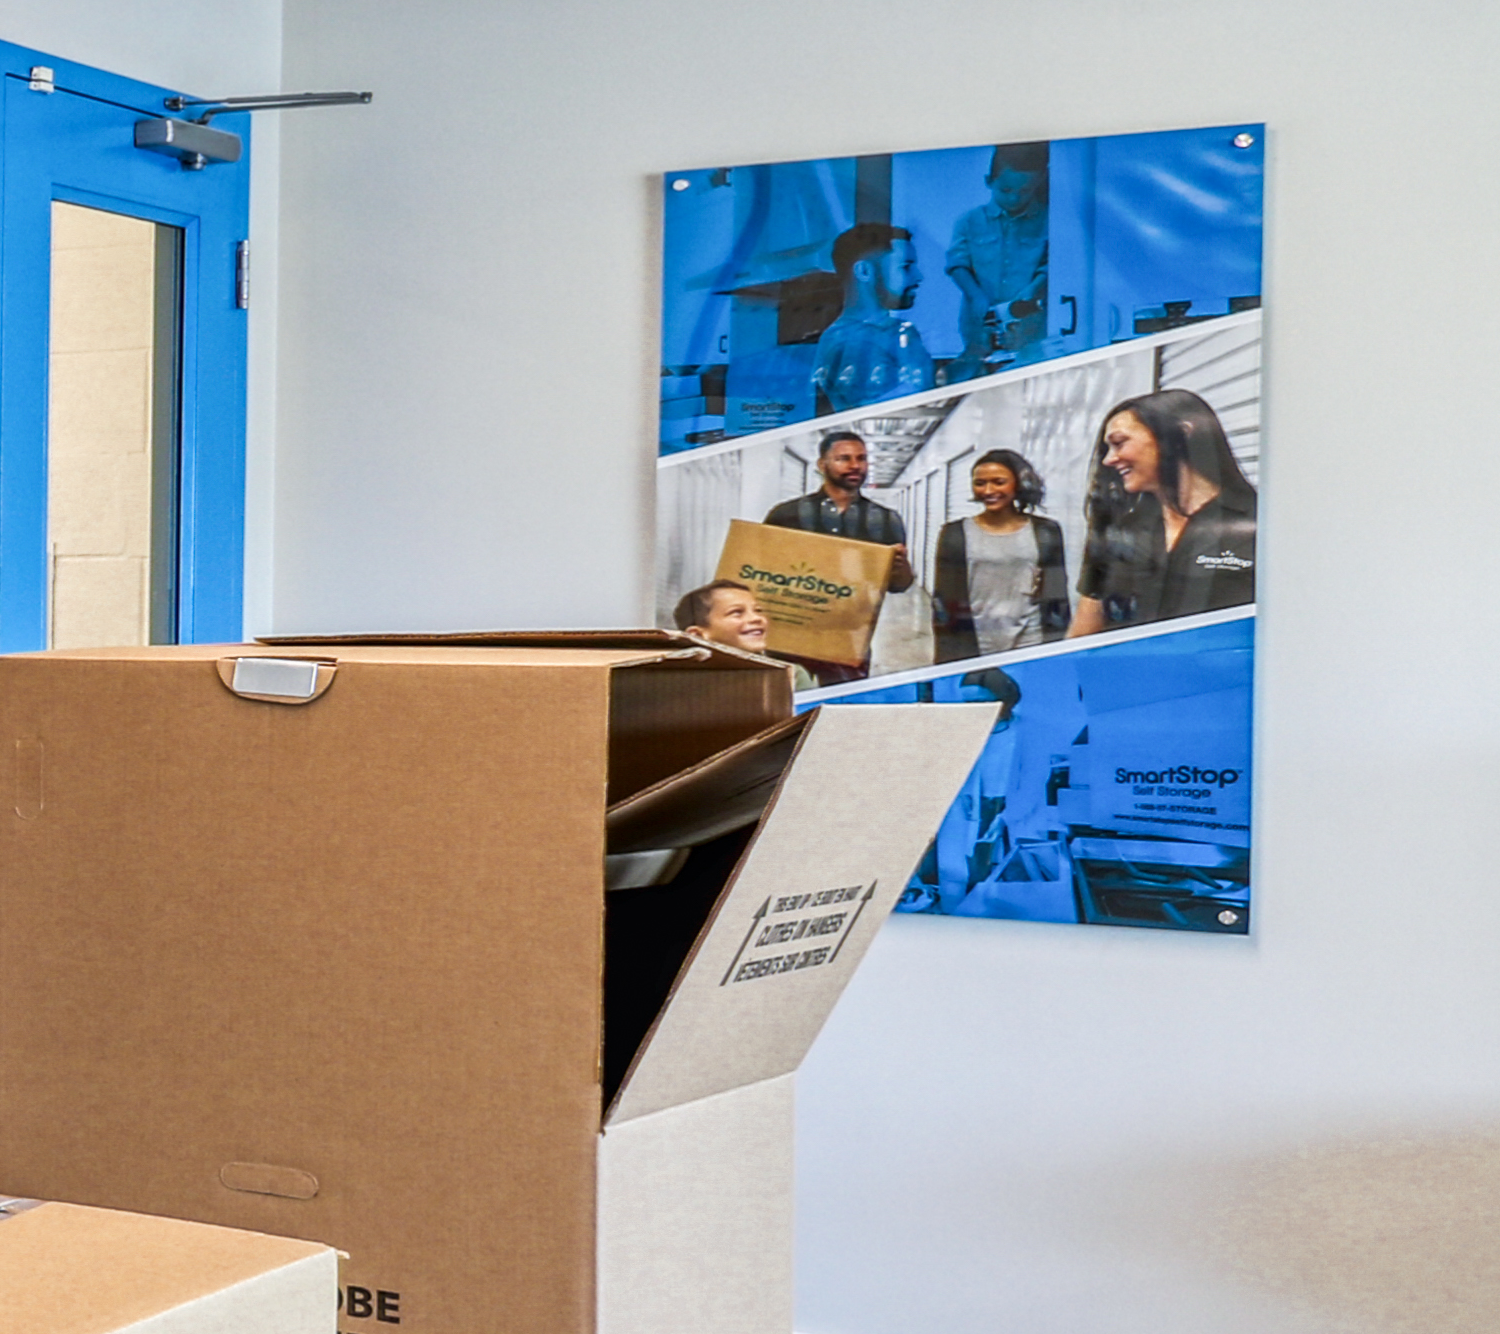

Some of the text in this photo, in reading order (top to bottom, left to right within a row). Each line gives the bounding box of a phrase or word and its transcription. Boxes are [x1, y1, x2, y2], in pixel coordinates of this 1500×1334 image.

[739, 564, 853, 598] SmartStop
[1115, 766, 1239, 788] SmartStop
[1133, 786, 1211, 799] Self Storage
